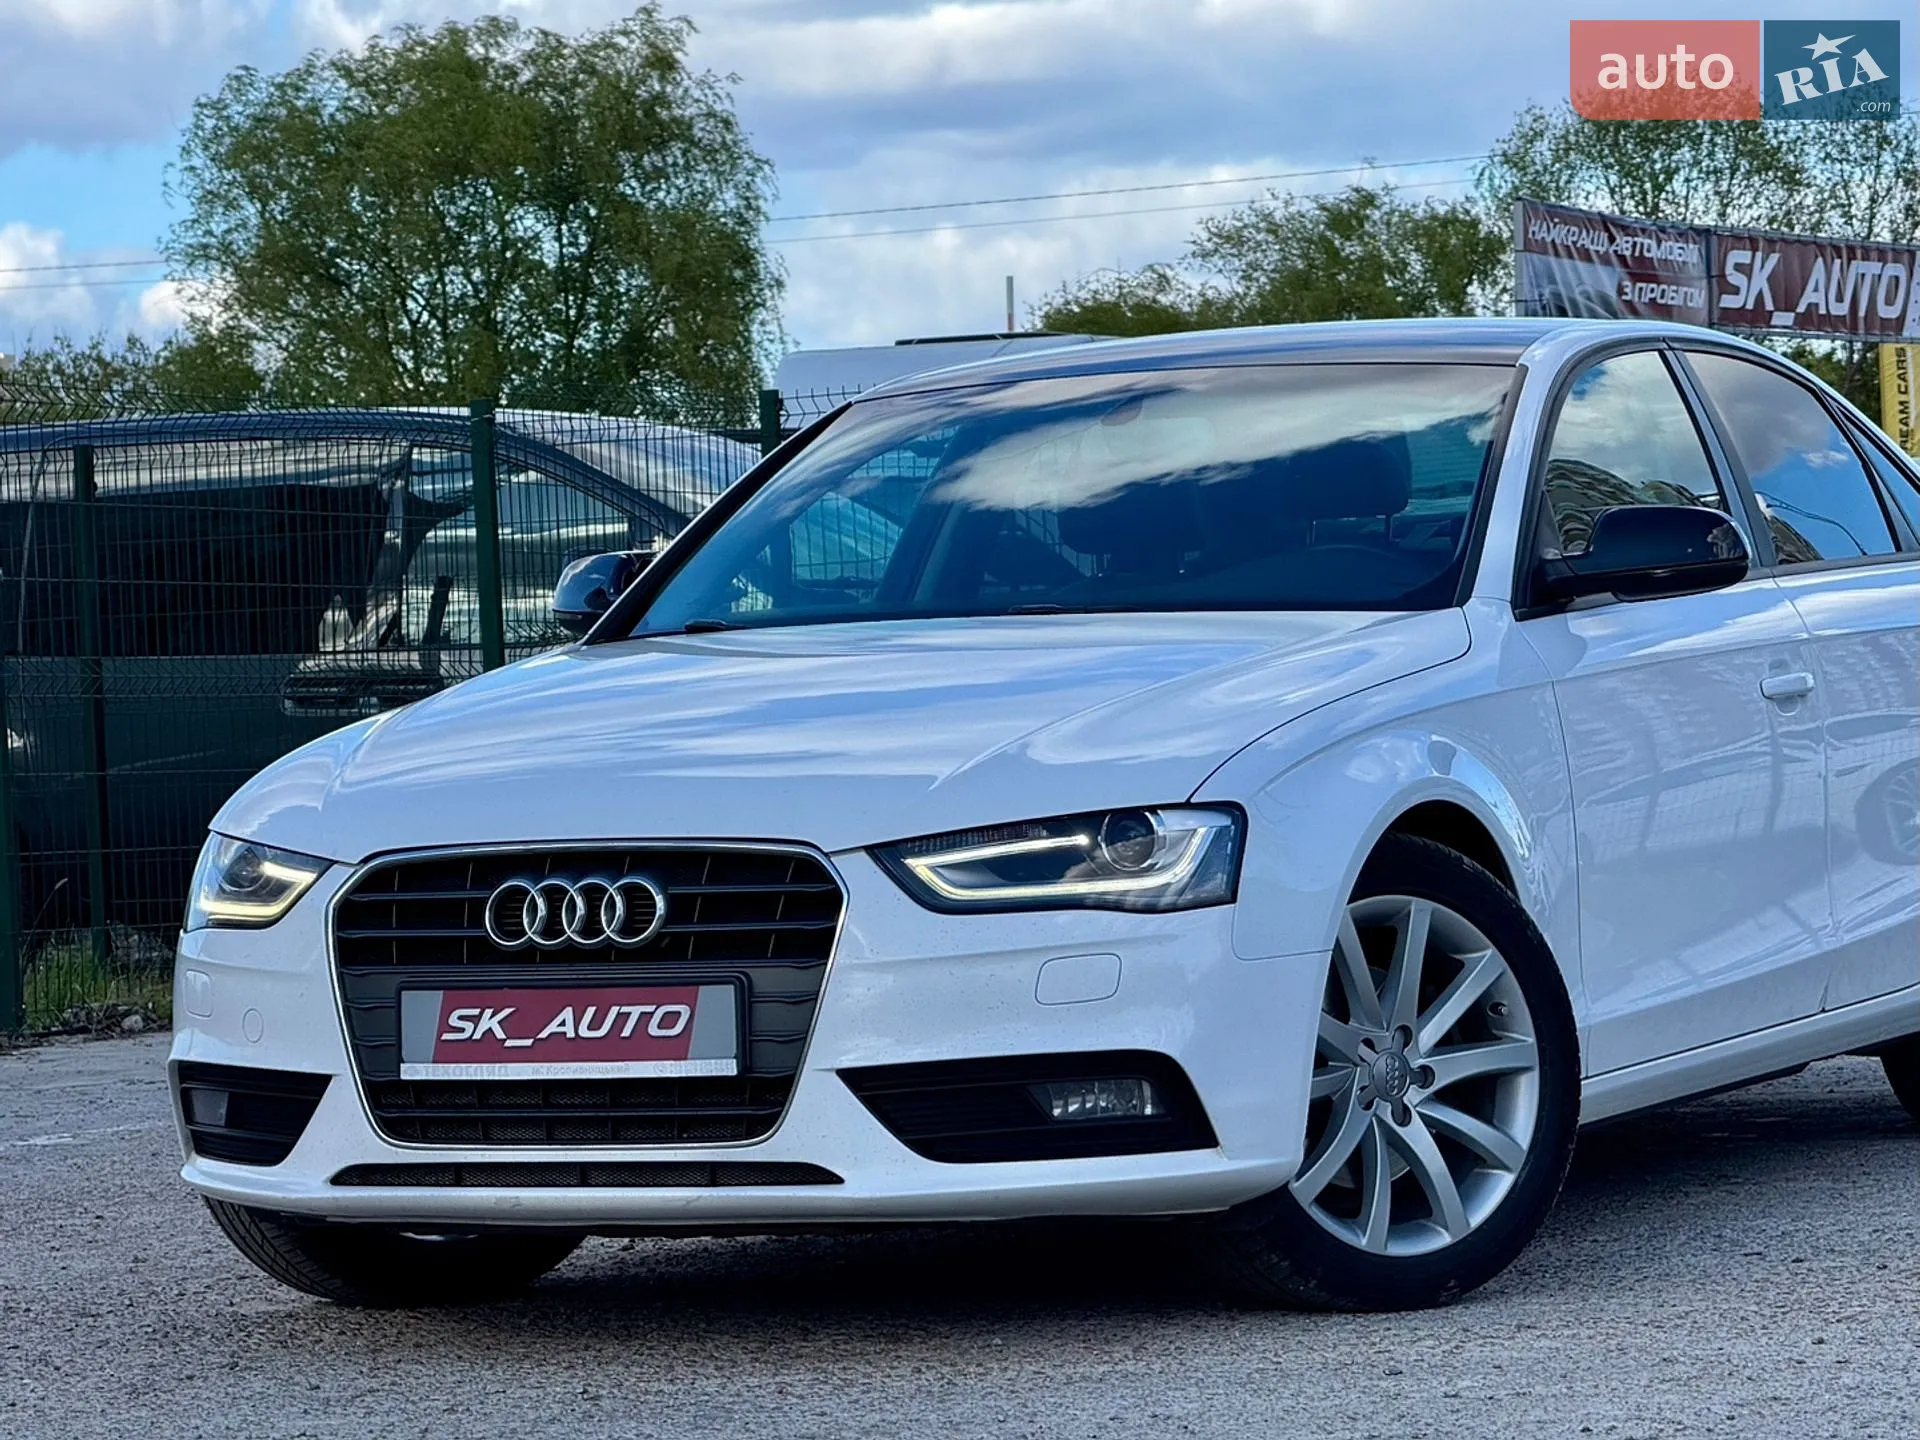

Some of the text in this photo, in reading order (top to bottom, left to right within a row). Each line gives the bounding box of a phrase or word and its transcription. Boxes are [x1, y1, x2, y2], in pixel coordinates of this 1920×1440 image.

[1719, 249, 1907, 327] SK_AUTO
[1894, 347, 1908, 395] CARS
[440, 1004, 691, 1047] SK_AUTO
